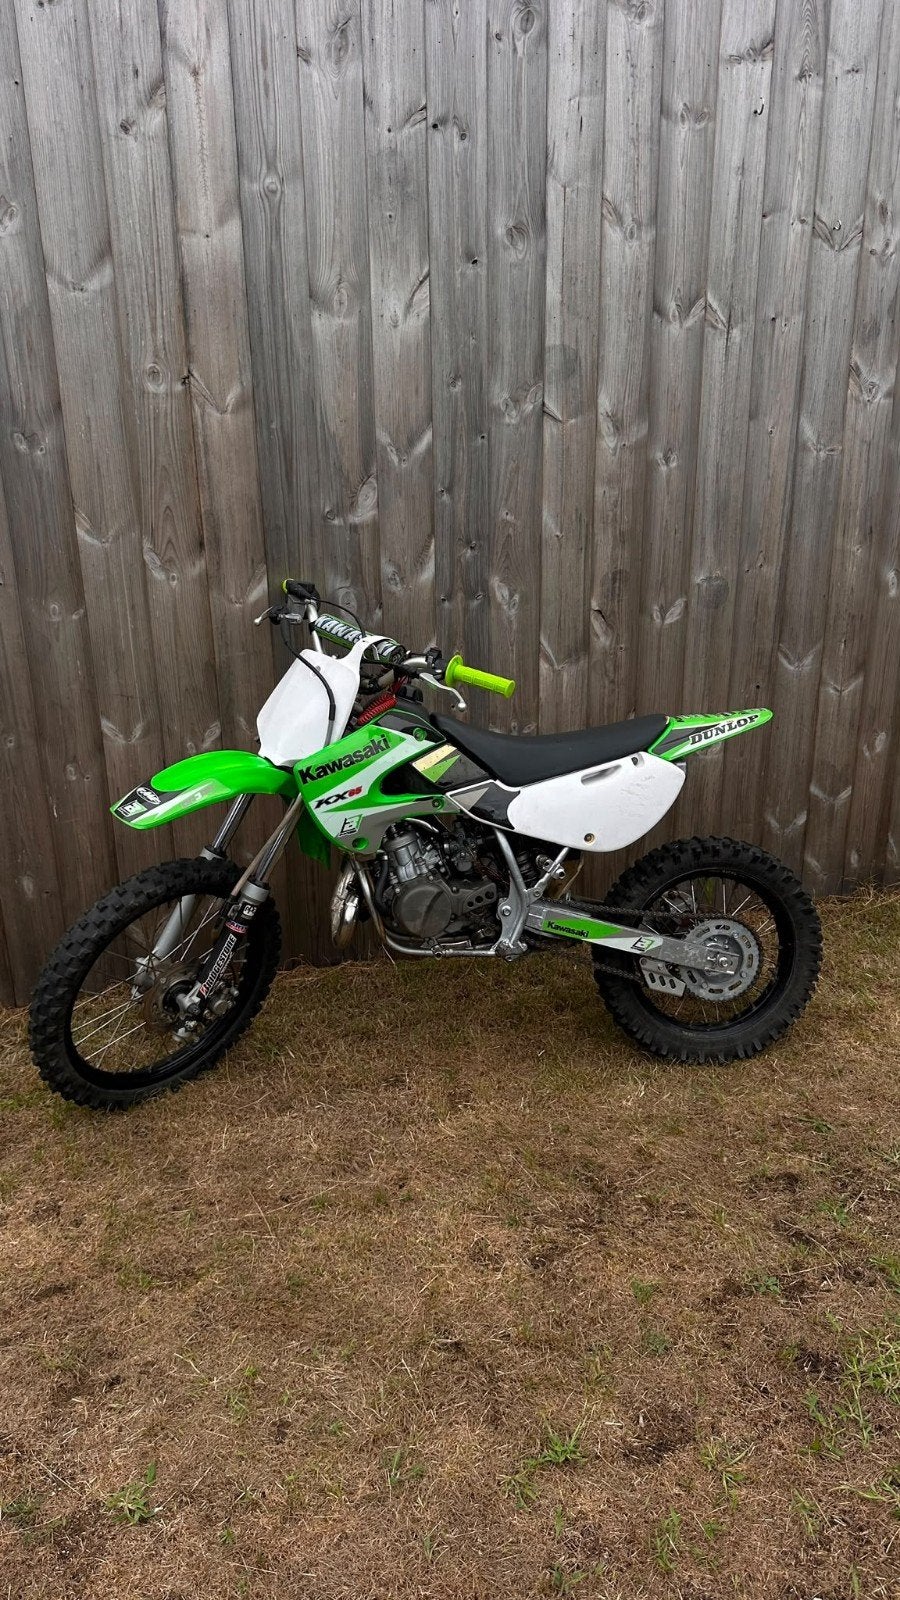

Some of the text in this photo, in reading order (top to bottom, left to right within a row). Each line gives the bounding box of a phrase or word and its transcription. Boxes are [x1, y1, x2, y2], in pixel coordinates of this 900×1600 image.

[690, 714, 759, 745] DUNLOP
[298, 734, 391, 785] Kawasaki
[547, 921, 590, 938] Kawasaki
[200, 933, 237, 999] BRIDGESTONE
